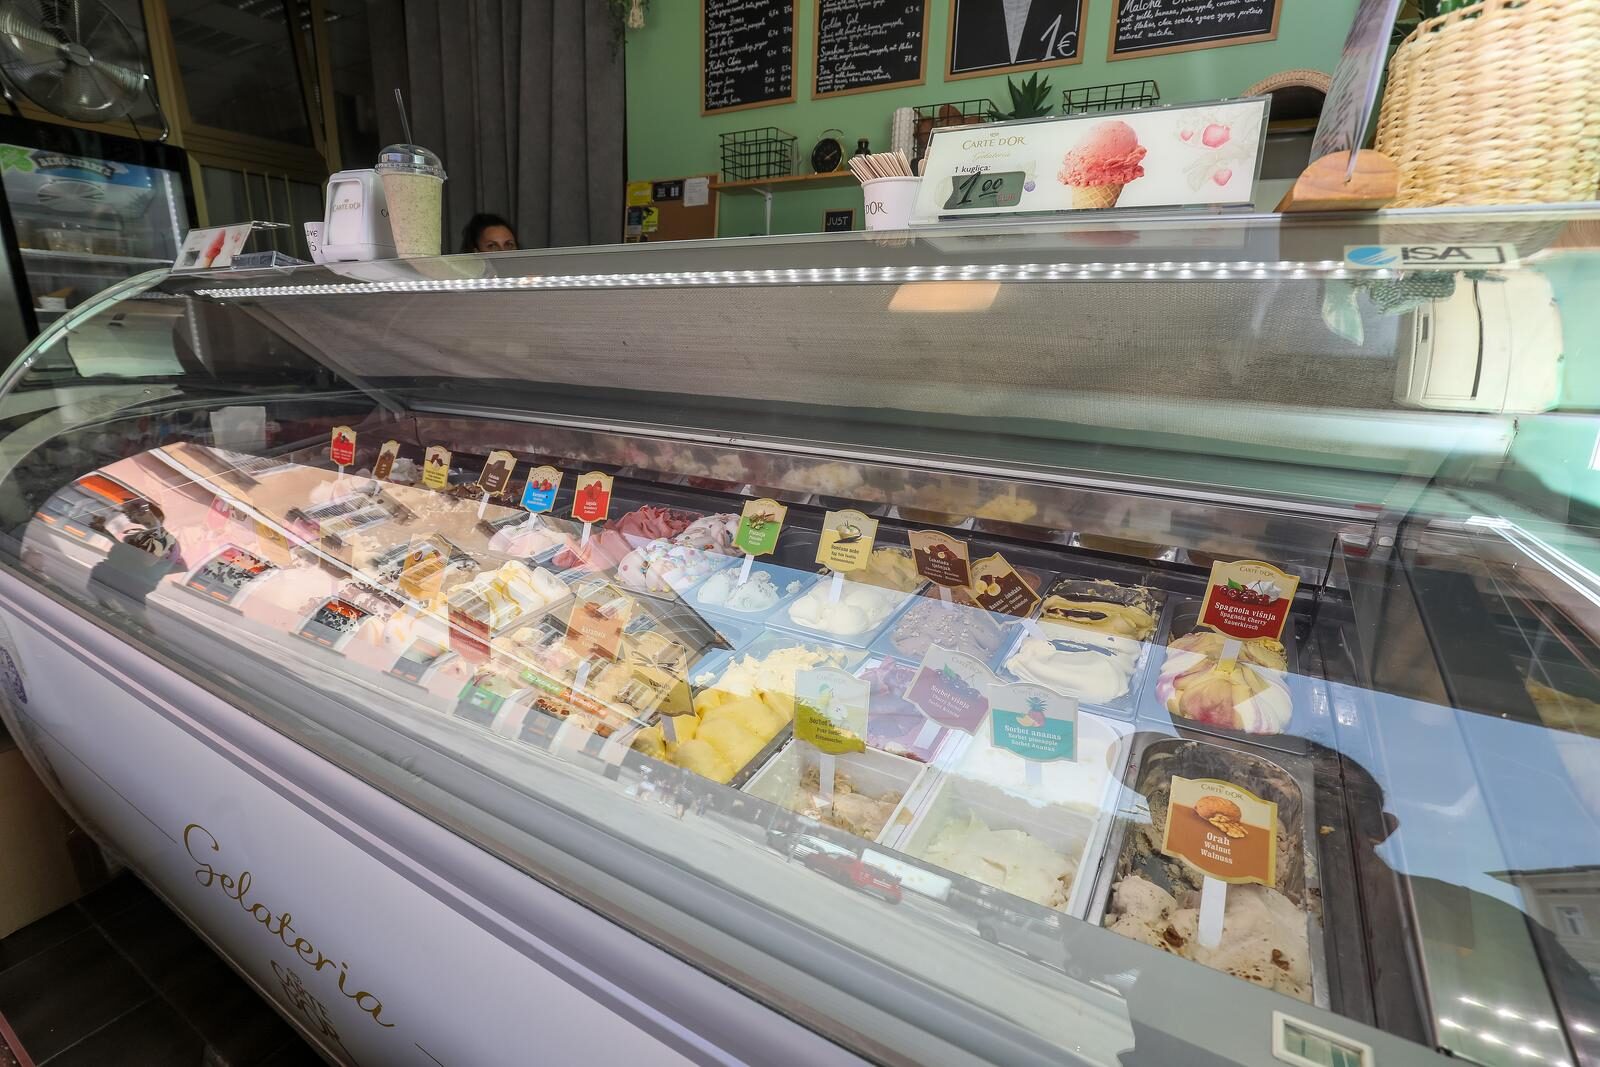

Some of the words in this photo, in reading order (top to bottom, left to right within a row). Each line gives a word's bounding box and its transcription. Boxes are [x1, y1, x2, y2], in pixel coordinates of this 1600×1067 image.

[962, 139, 996, 151] CARTE
[827, 216, 849, 226] JUST
[1401, 246, 1473, 261] ISA
[1247, 616, 1268, 627] Cherry
[1252, 609, 1276, 622] višnja
[1223, 618, 1259, 631] Sauerkirsch
[930, 684, 951, 698] Sorbet
[1004, 724, 1029, 735] Sorbet
[1031, 730, 1062, 741] ananas
[1206, 831, 1230, 846] Orah
[1204, 841, 1231, 854] Walnut
[1200, 848, 1233, 865] Walnuss
[183, 823, 396, 1028] Gelateria
